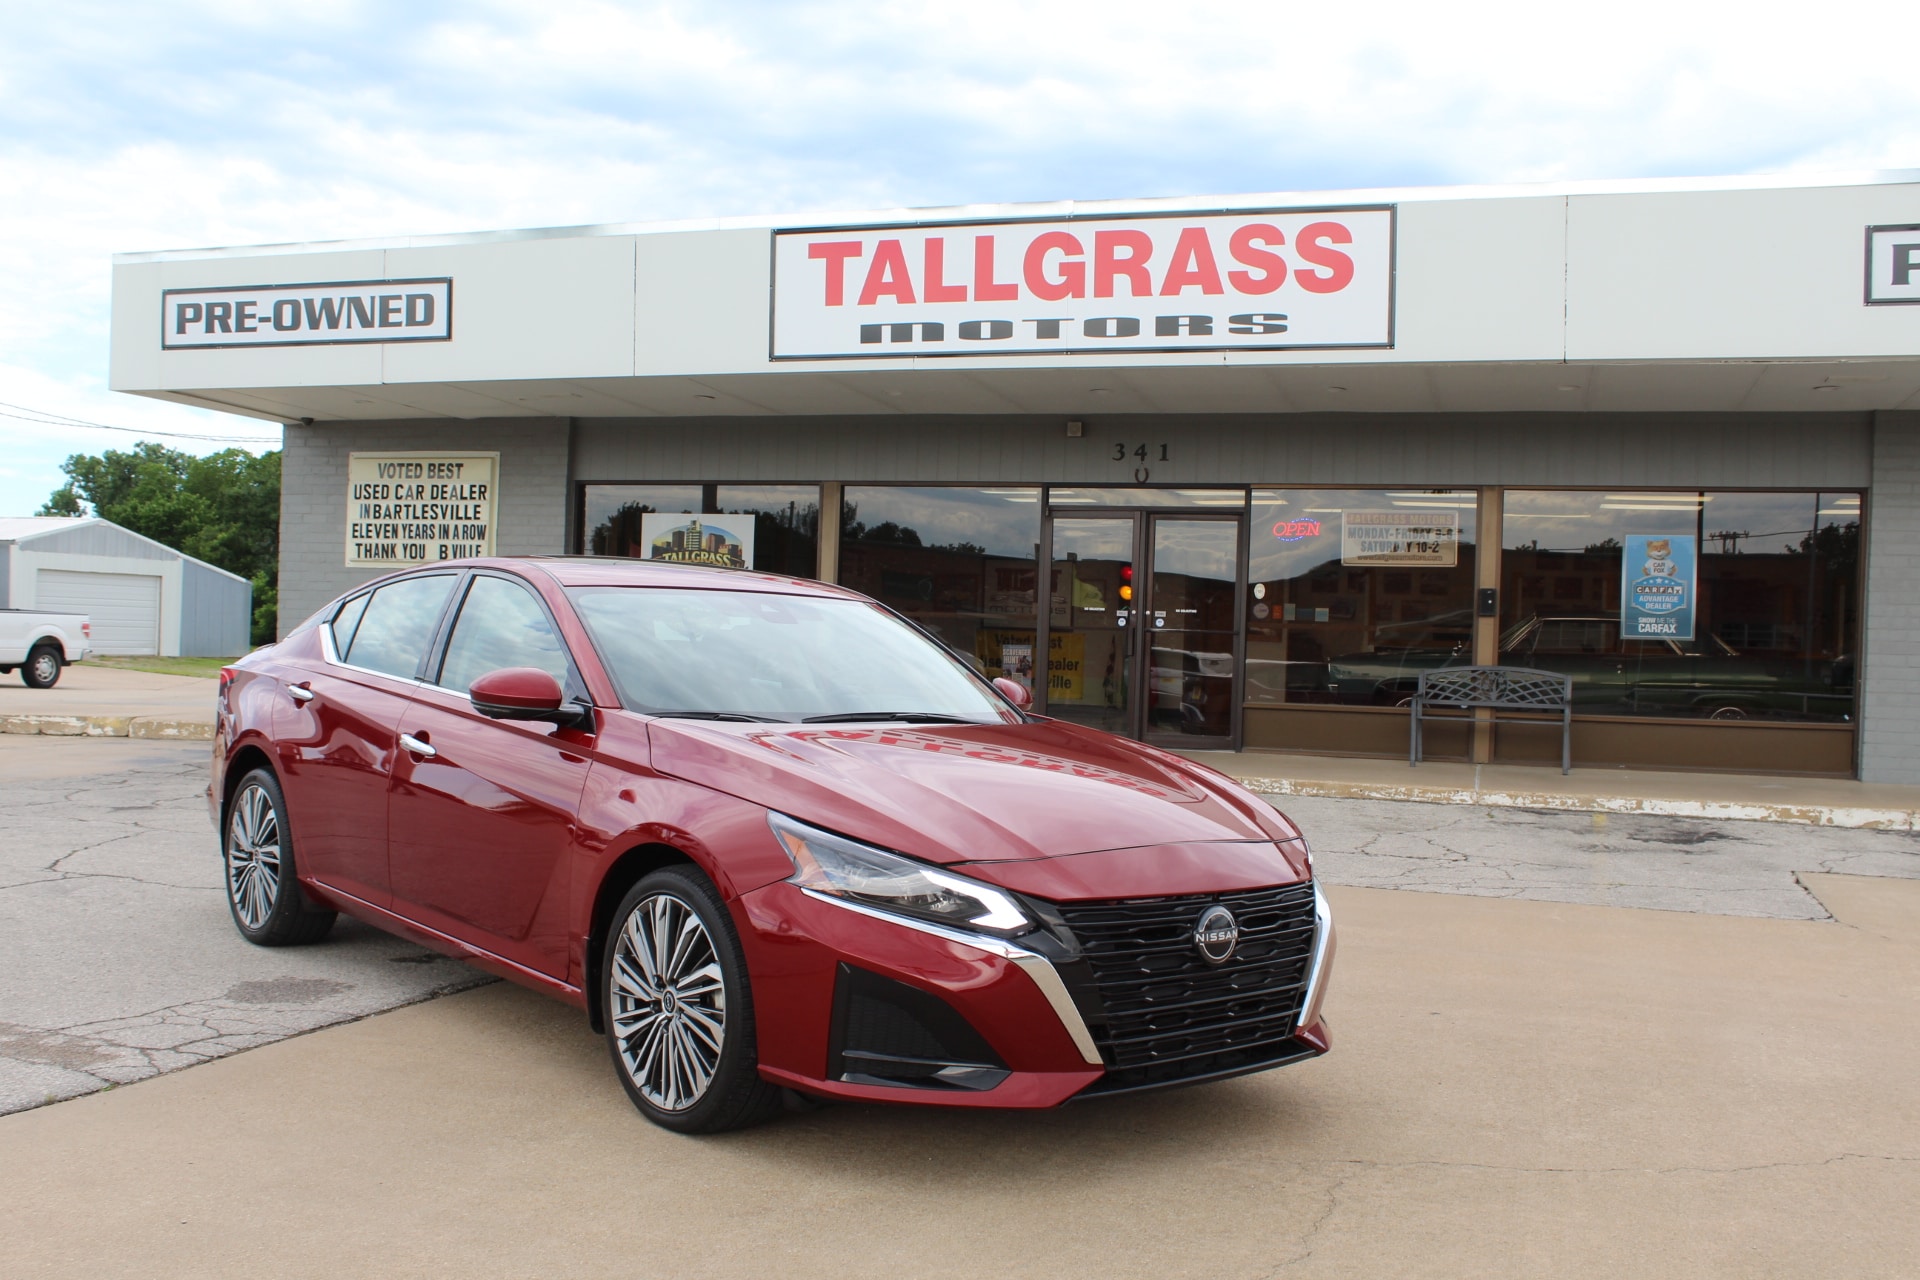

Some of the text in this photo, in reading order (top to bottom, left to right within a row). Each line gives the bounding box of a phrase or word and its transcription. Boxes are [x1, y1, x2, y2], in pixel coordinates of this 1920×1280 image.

[808, 221, 1355, 306] TALLGRASS
[176, 293, 435, 334] PRE-OWNED
[860, 312, 1288, 344] MOTORS
[378, 463, 464, 479] VOTED BEST
[354, 484, 487, 500] USED CAR DEALER
[360, 504, 481, 520] IN BARTLESVILLE
[1346, 513, 1454, 525] TALLGRASS MOTORS
[352, 523, 487, 540] ELEVEN YEARS IN A ROW
[1272, 521, 1320, 537] OPEN
[1347, 527, 1431, 540] MONDAY-FRIDAY
[355, 543, 397, 559] THANK
[402, 544, 426, 560] YOU
[439, 544, 448, 560] B
[1361, 541, 1440, 553] SATURDAY 10-2
[663, 551, 731, 567] TALLGRASS
[1636, 586, 1682, 594] CARFAX
[1638, 623, 1677, 633] CARFAX
[1195, 928, 1238, 942] NISSAN
